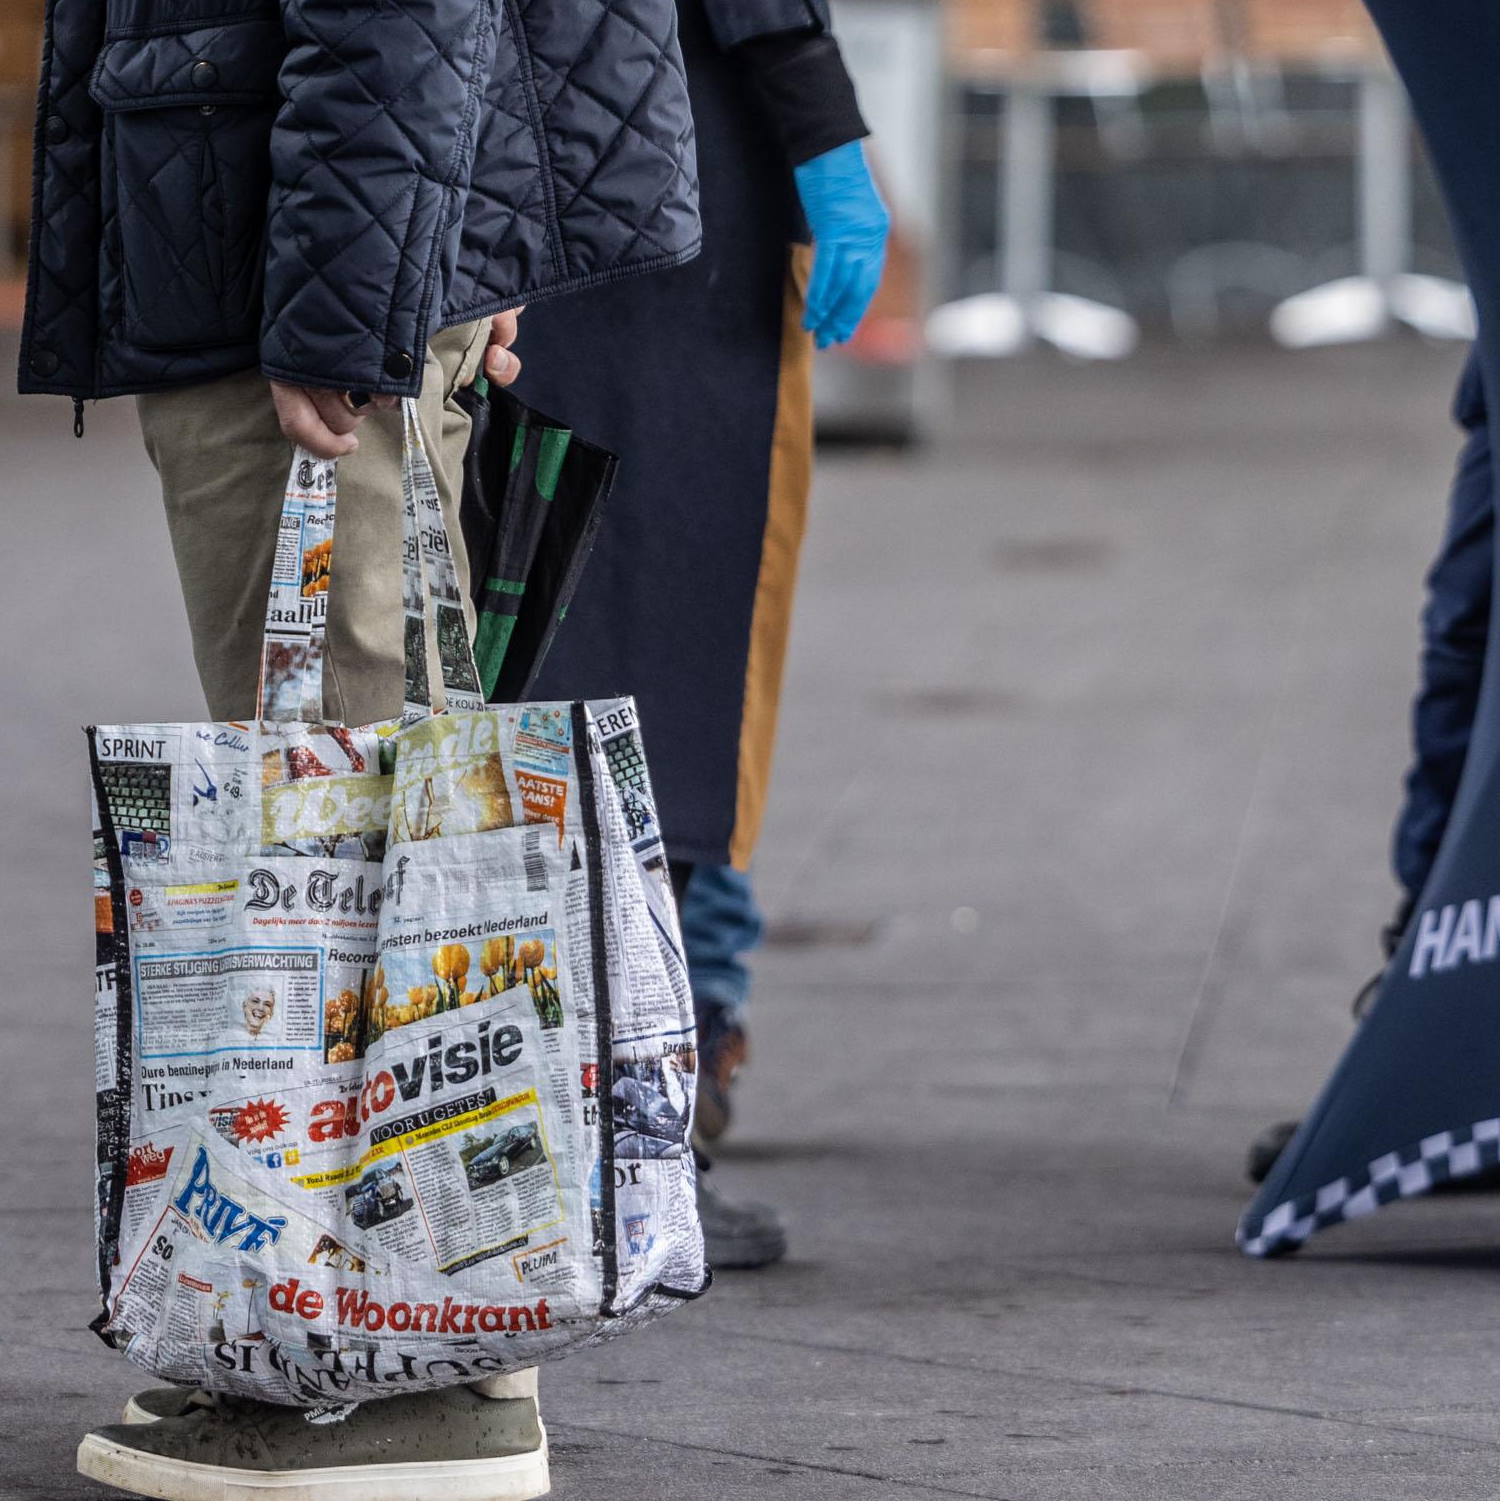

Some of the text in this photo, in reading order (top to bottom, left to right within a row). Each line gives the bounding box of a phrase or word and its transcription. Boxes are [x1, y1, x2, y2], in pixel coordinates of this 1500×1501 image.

[101, 738, 167, 759] SPRINT
[243, 868, 298, 913] De
[252, 917, 287, 927] Dagelijks
[423, 924, 483, 944] bezoekt
[484, 911, 549, 937] Nederland
[140, 962, 173, 978] STERKE
[173, 958, 219, 976] STIJGING
[141, 1065, 165, 1079] Dure
[222, 1059, 230, 1071] in
[232, 1057, 294, 1071] Nederland
[371, 1117, 417, 1143] VOOR
[418, 1112, 430, 1127] U
[521, 1251, 558, 1275] PLUIM
[268, 1277, 553, 1334] de Woonkrant
